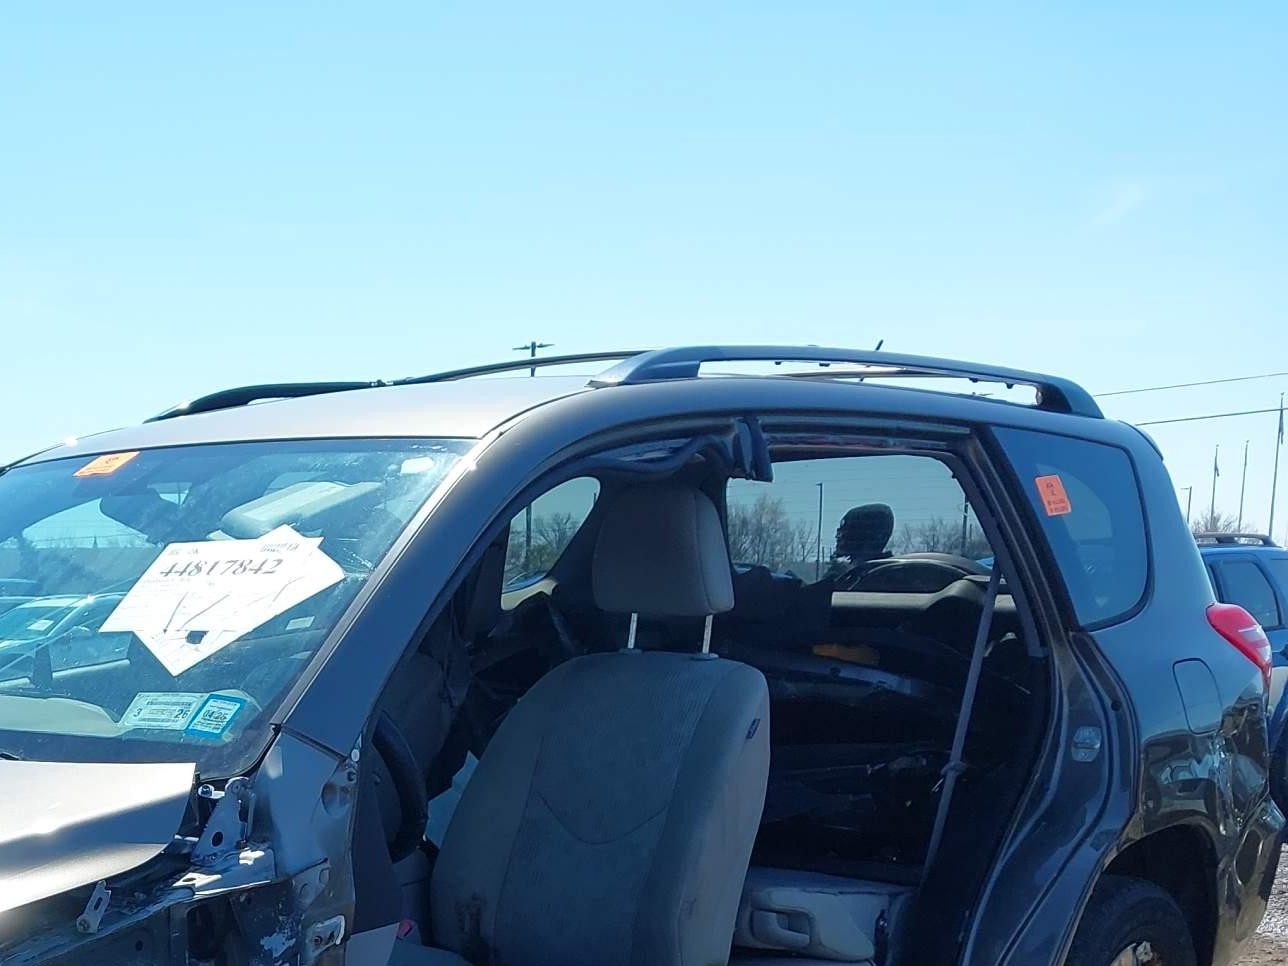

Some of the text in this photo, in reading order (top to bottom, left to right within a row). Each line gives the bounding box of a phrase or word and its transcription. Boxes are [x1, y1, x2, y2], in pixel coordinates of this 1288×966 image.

[159, 558, 284, 578] 44817842
[133, 707, 191, 719] 3 26
